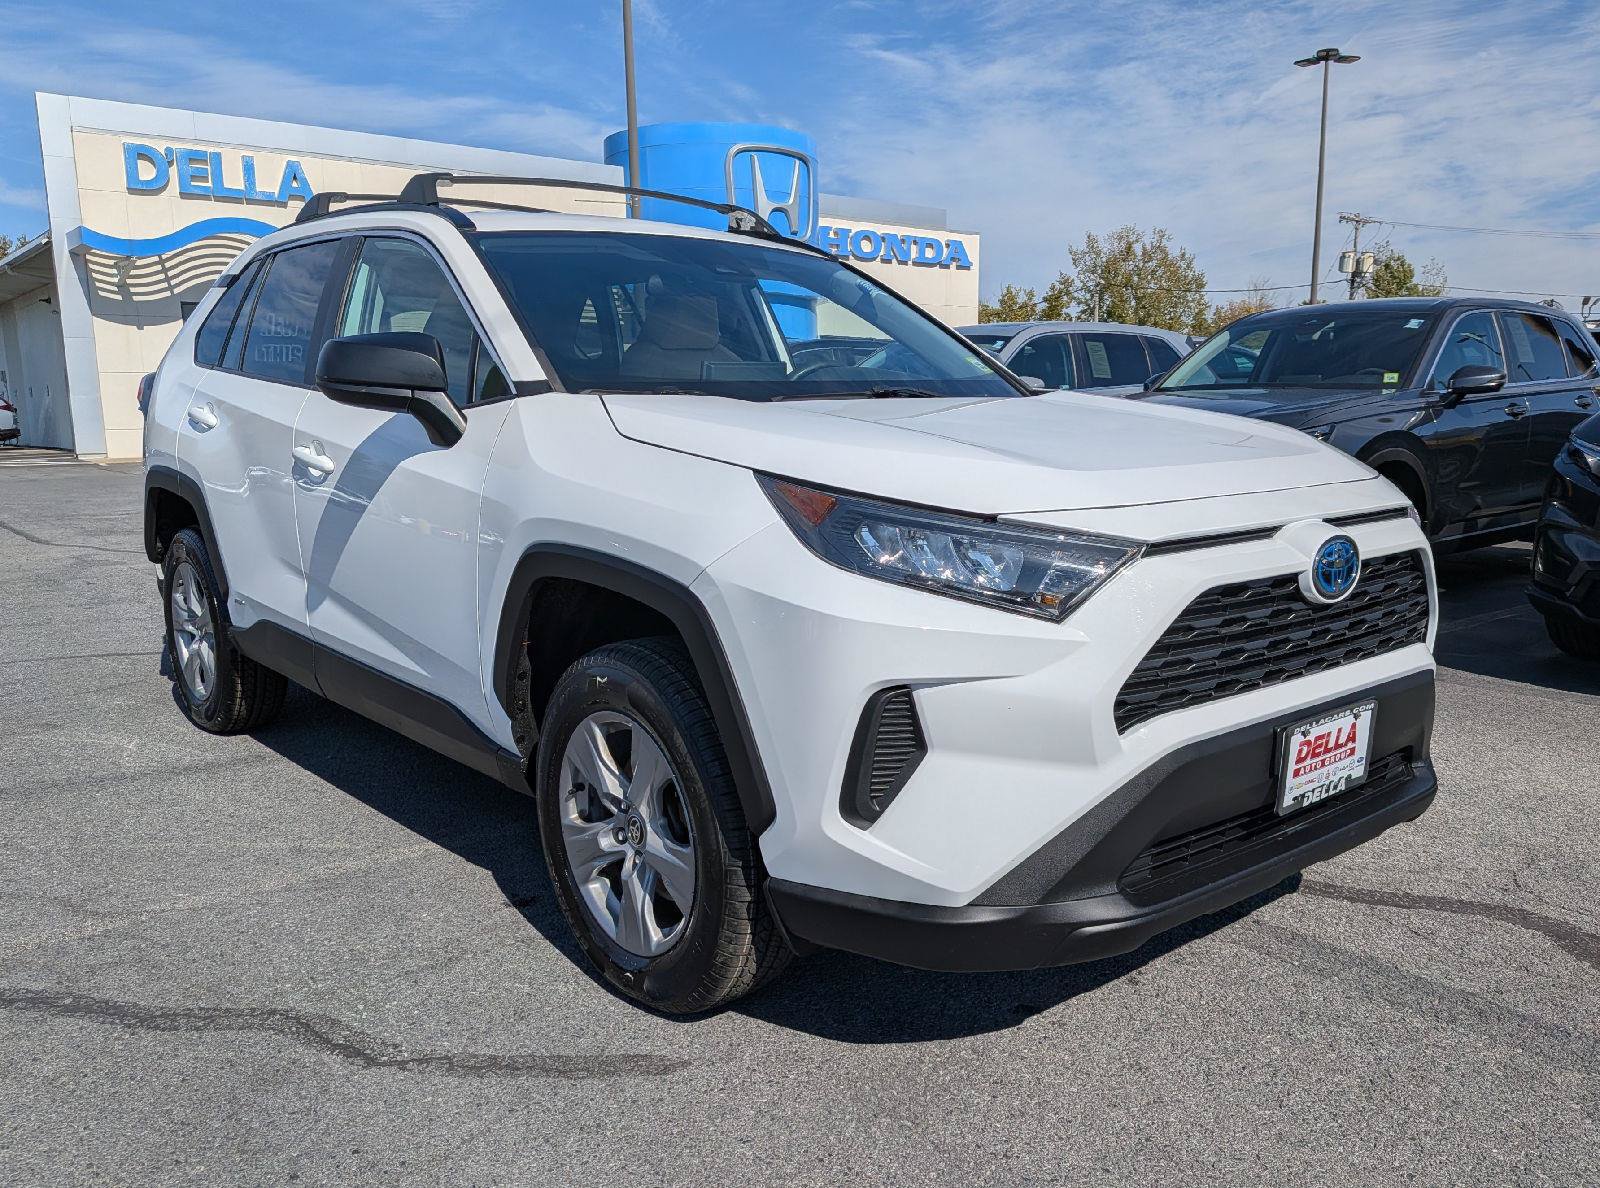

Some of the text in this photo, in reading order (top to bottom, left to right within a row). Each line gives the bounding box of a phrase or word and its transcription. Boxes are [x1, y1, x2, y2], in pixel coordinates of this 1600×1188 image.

[123, 142, 314, 203] D'ELLA
[819, 226, 973, 269] HONDA
[1294, 703, 1375, 735] DELLACARS.COM
[1295, 722, 1357, 765] DELLA
[1299, 759, 1322, 776] AUTO
[1325, 749, 1351, 766] GROUP
[1303, 776, 1346, 807] DELLA
